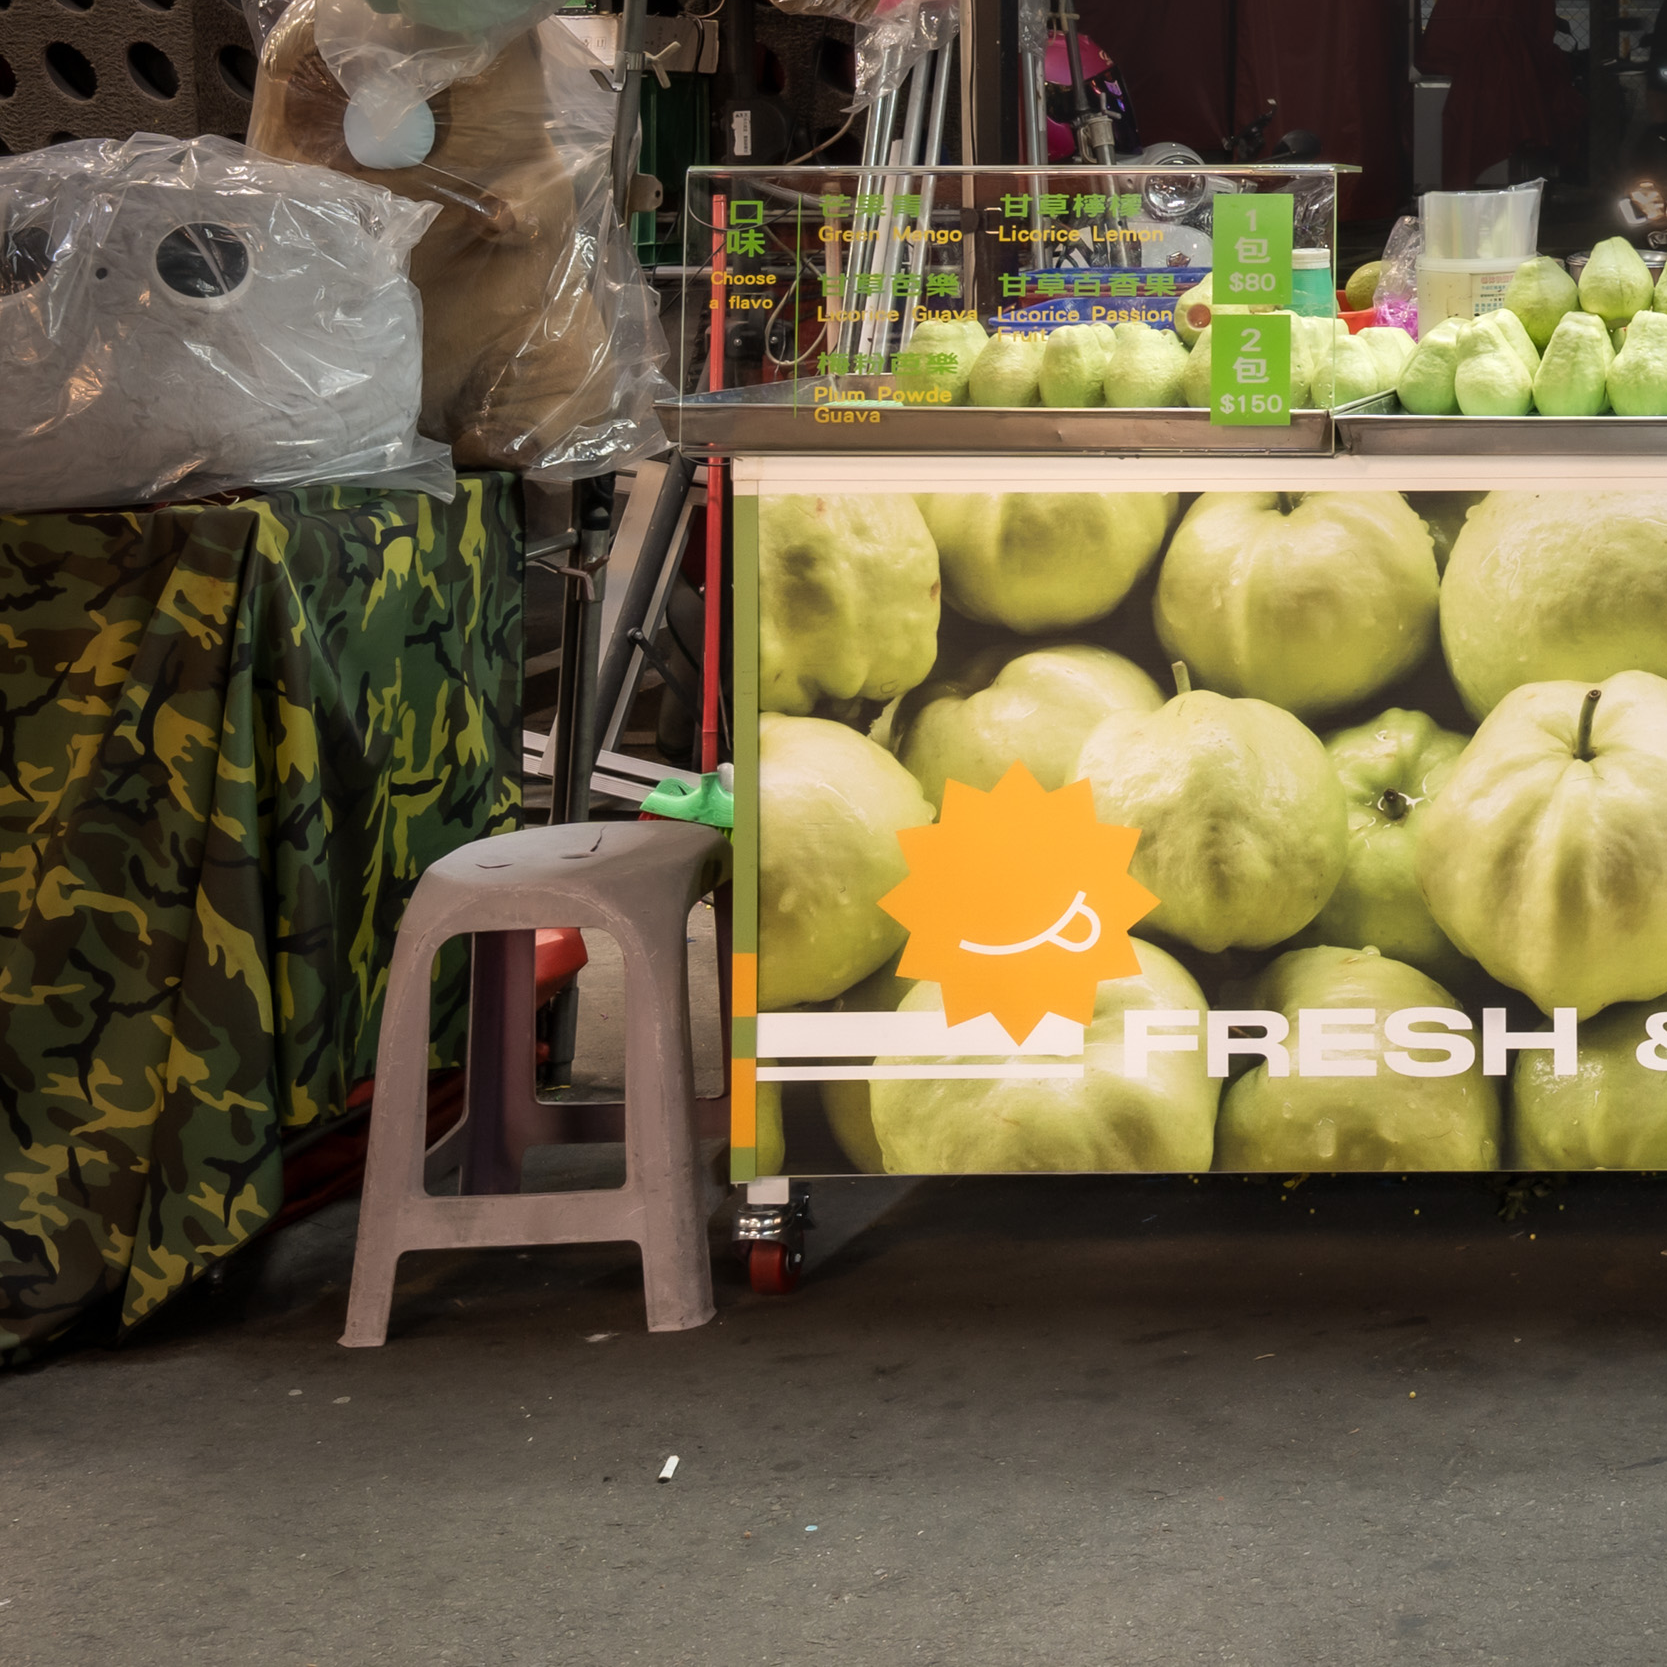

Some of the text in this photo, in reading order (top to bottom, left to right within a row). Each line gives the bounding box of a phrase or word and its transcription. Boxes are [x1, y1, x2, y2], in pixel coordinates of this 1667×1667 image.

[1000, 193, 1144, 218] 甘草檸檬
[727, 200, 765, 257] 口味
[818, 226, 962, 245] Green Mango
[999, 226, 1164, 242] Licorice Lemon
[711, 271, 776, 285] Choose
[817, 273, 960, 297] 甘草芭樂
[998, 273, 1176, 297] 甘草百香果
[1229, 272, 1276, 293] $80
[709, 295, 773, 309] a flavo
[817, 306, 978, 322] Licorice Guava
[998, 306, 1173, 322] Licorice Passion
[998, 327, 1049, 342] Fruit
[814, 387, 951, 402] Plum Powde
[1219, 394, 1283, 414] $150
[814, 407, 880, 423] Guava
[1123, 1007, 1578, 1080] FRESH
